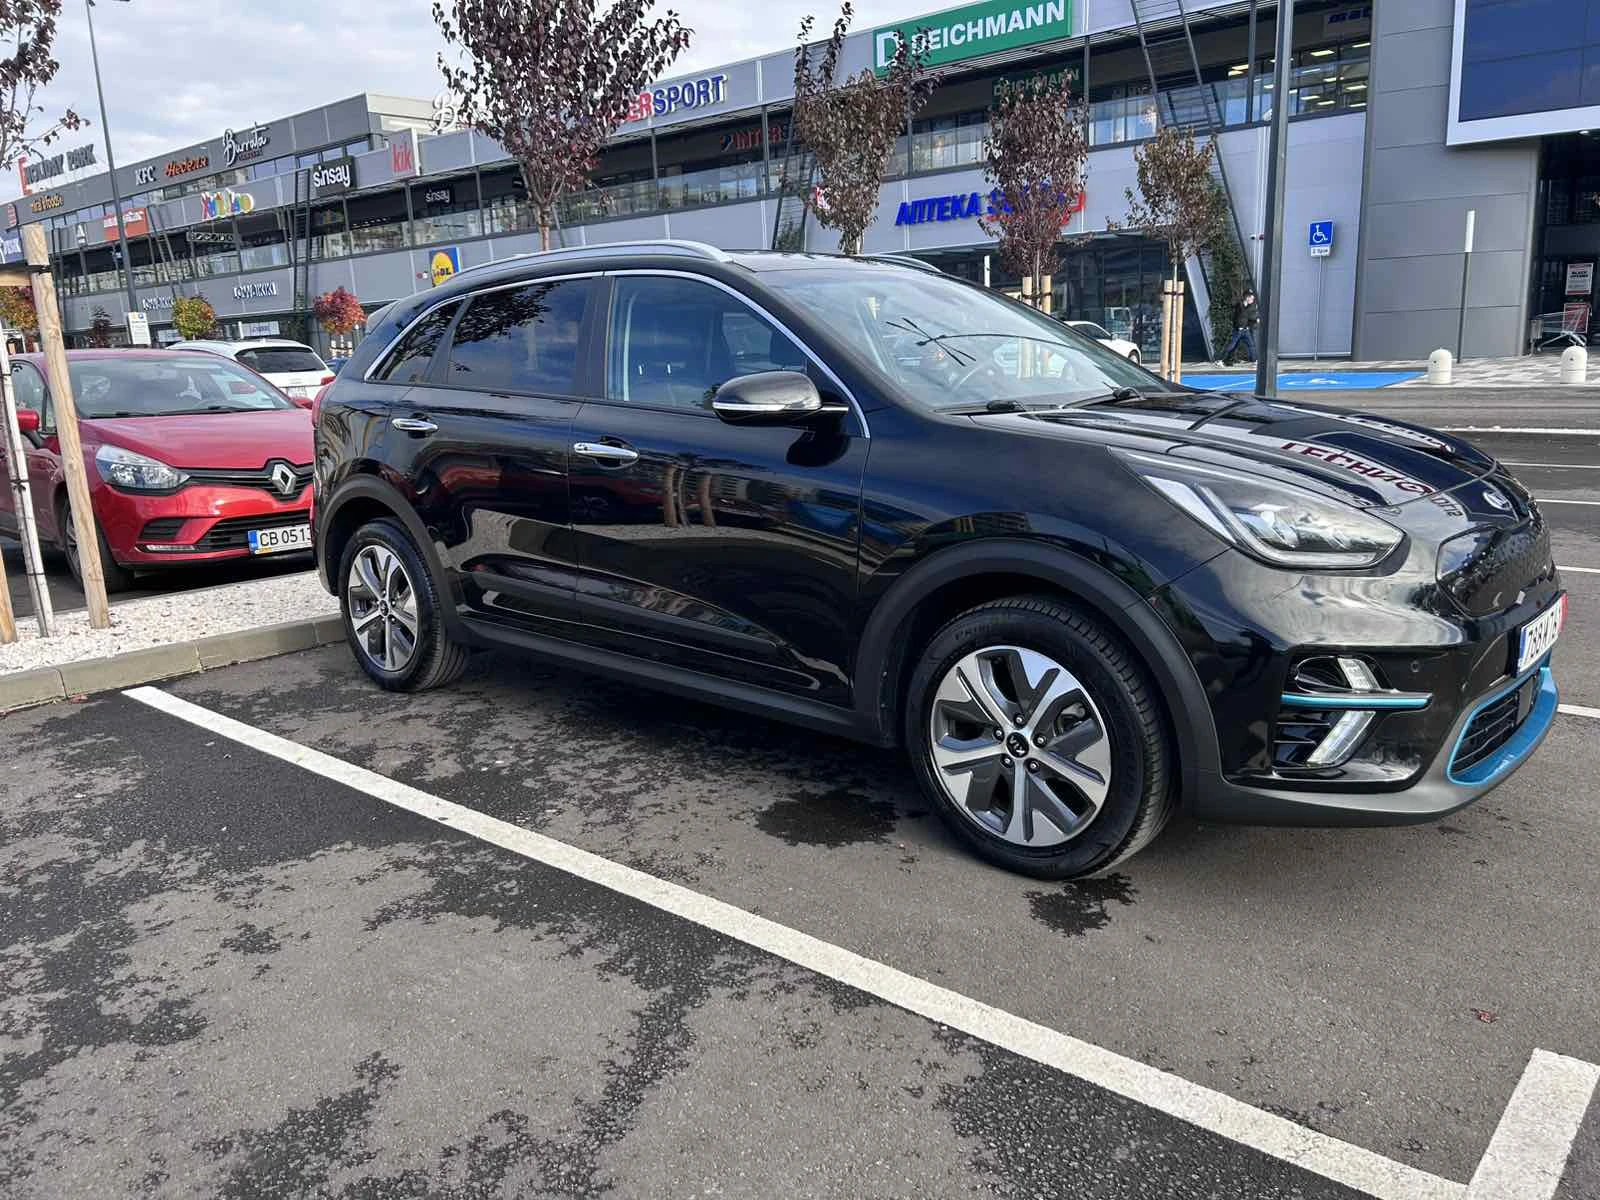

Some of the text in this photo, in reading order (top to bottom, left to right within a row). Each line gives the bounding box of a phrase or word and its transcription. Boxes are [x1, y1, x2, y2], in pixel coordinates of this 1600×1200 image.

[912, 2, 1065, 55] DEICHMANN
[66, 143, 97, 172] PARK
[391, 143, 413, 174] kik
[134, 165, 156, 186] KFC
[312, 164, 351, 188] sinsay
[425, 187, 451, 204] sinsay
[895, 191, 982, 226] АПТЕКА
